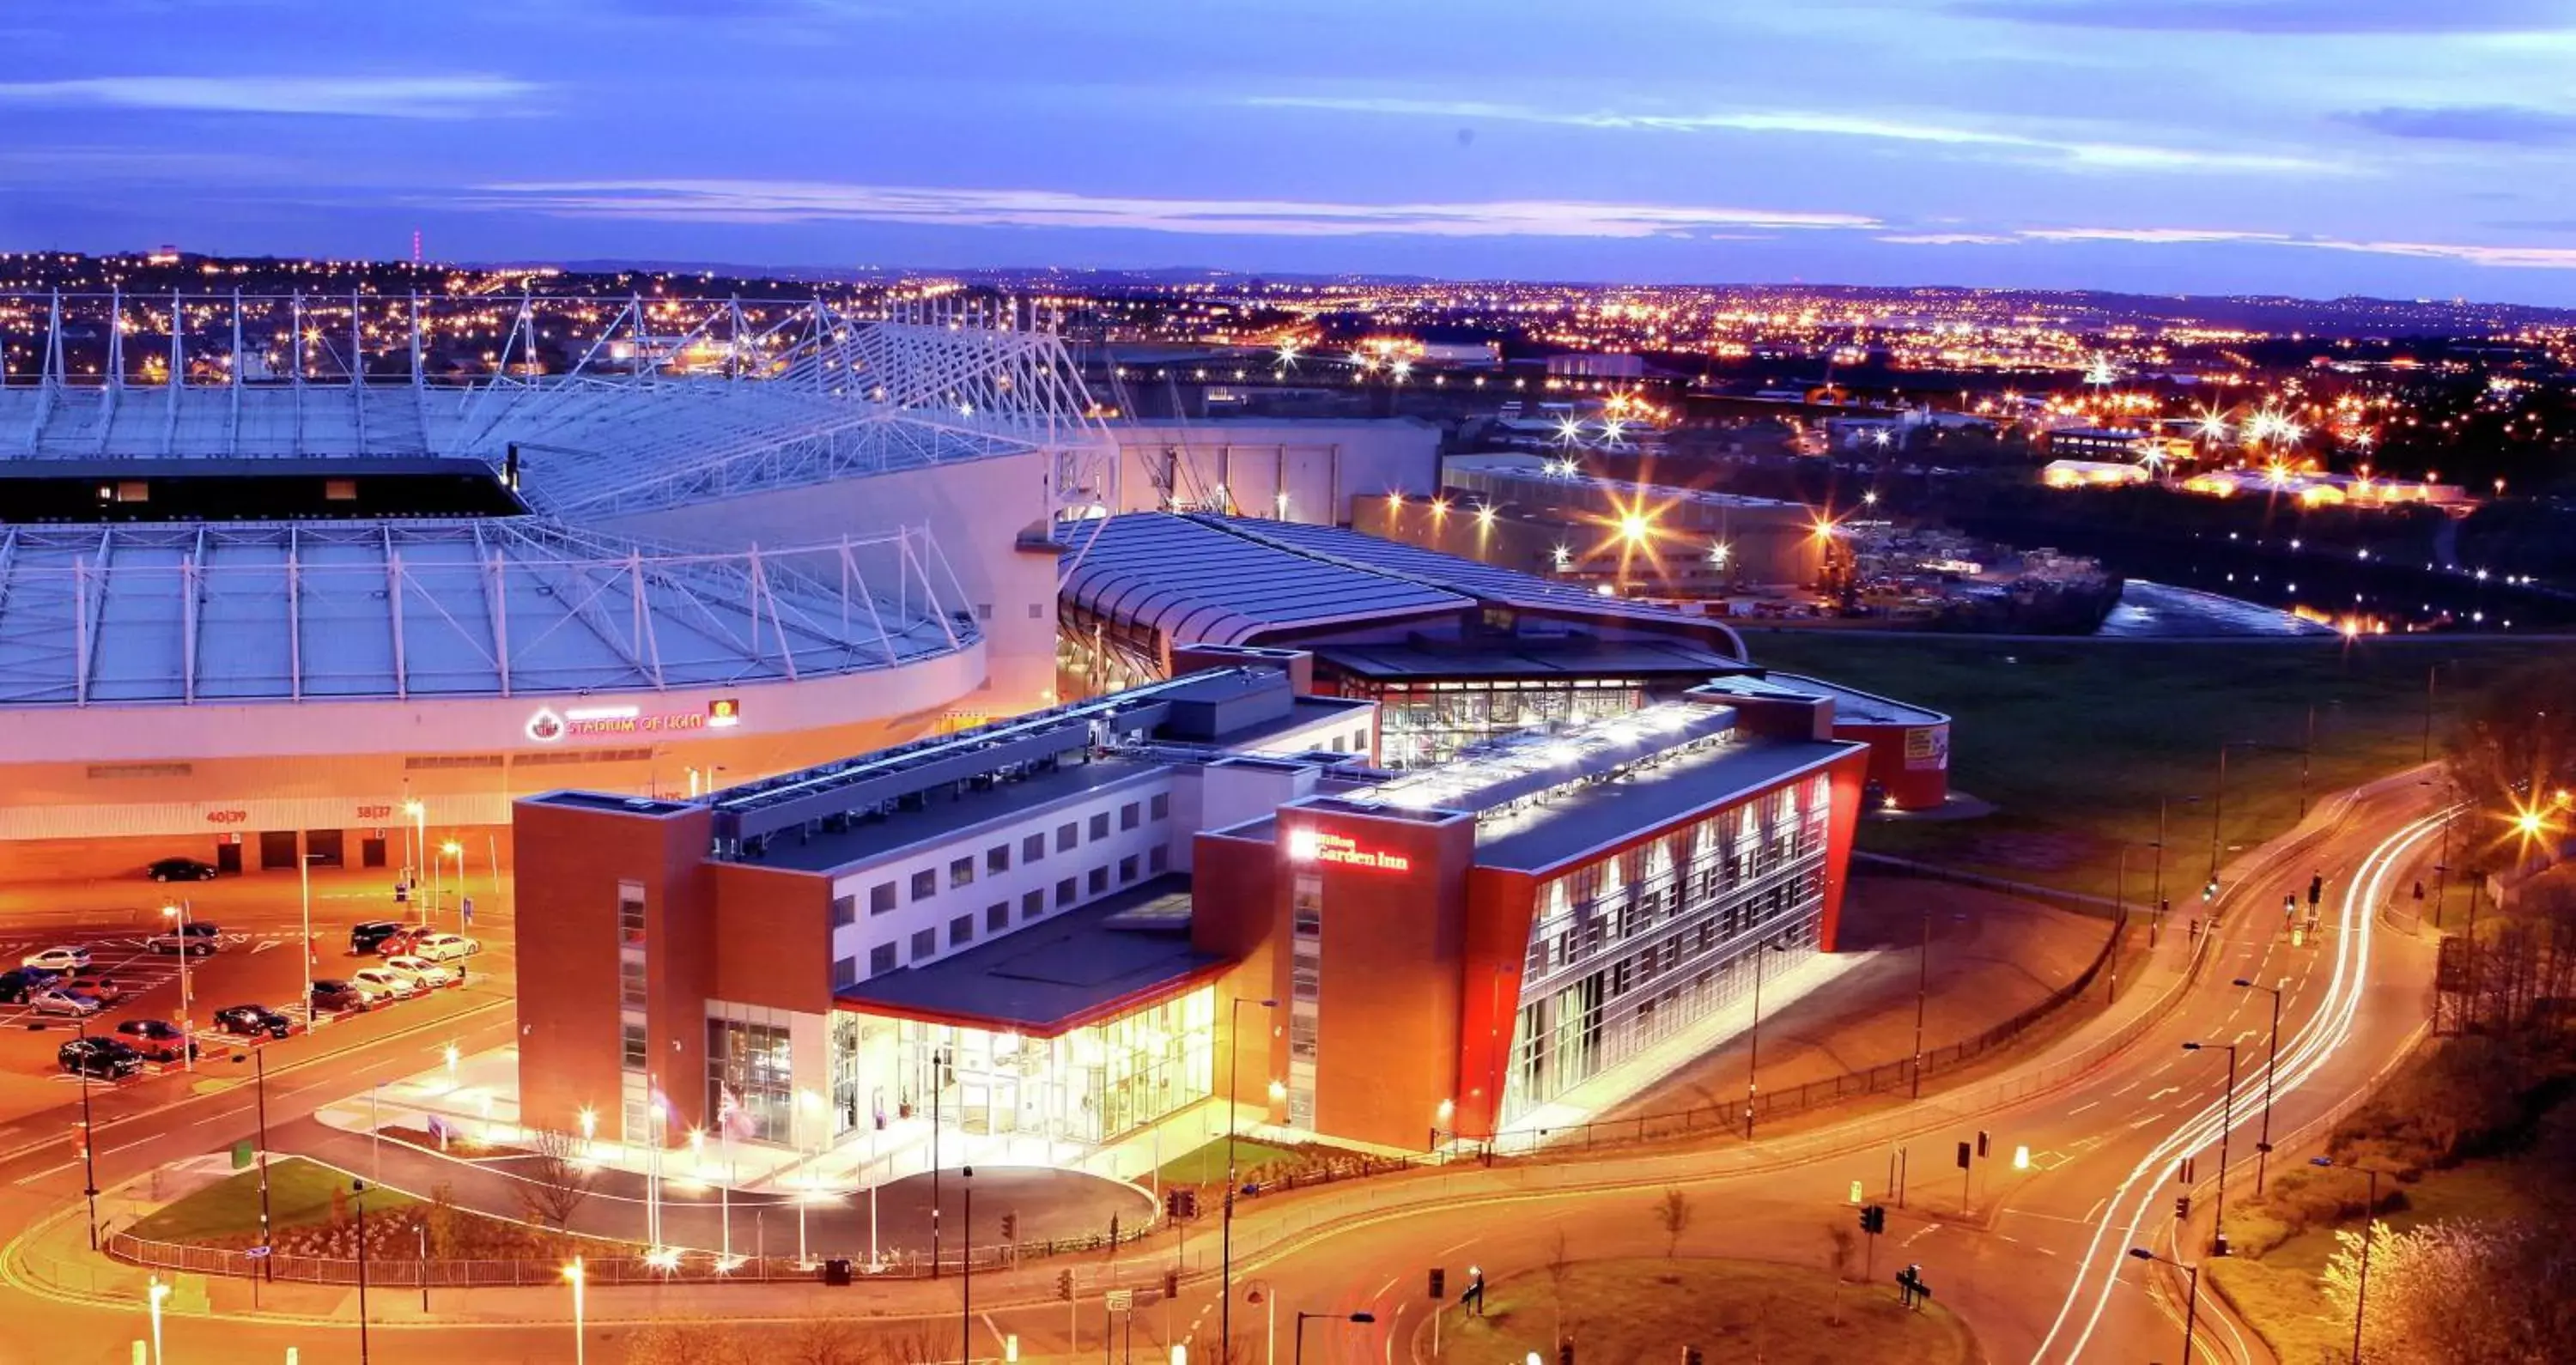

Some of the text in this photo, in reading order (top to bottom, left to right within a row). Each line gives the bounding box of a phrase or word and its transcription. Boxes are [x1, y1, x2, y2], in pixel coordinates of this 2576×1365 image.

[641, 715, 660, 731] OF
[1319, 845, 1408, 871] Garden Inn
